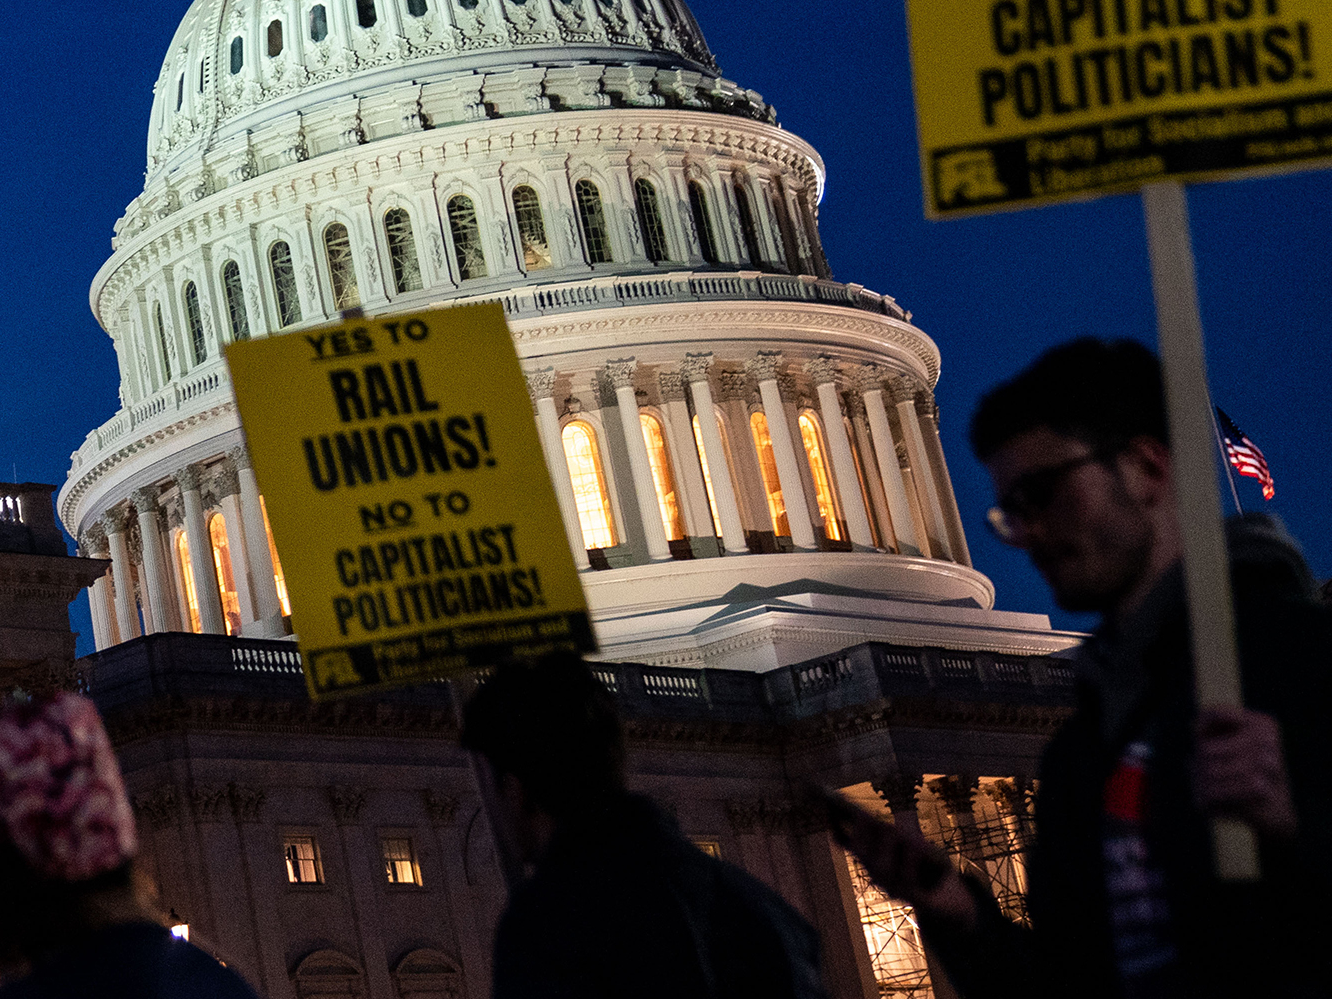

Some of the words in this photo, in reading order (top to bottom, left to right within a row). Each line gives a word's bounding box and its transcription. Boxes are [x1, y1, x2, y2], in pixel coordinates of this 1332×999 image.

[978, 21, 1317, 129] POLITICIANS!
[305, 326, 373, 358] YES
[382, 319, 430, 345] TO
[328, 359, 439, 423] RAIL
[302, 413, 497, 492] UNIONS!
[358, 500, 416, 530] NO
[424, 491, 471, 518] TO
[334, 524, 520, 589] CAPITALIST
[331, 568, 548, 637] POLITICIANS!
